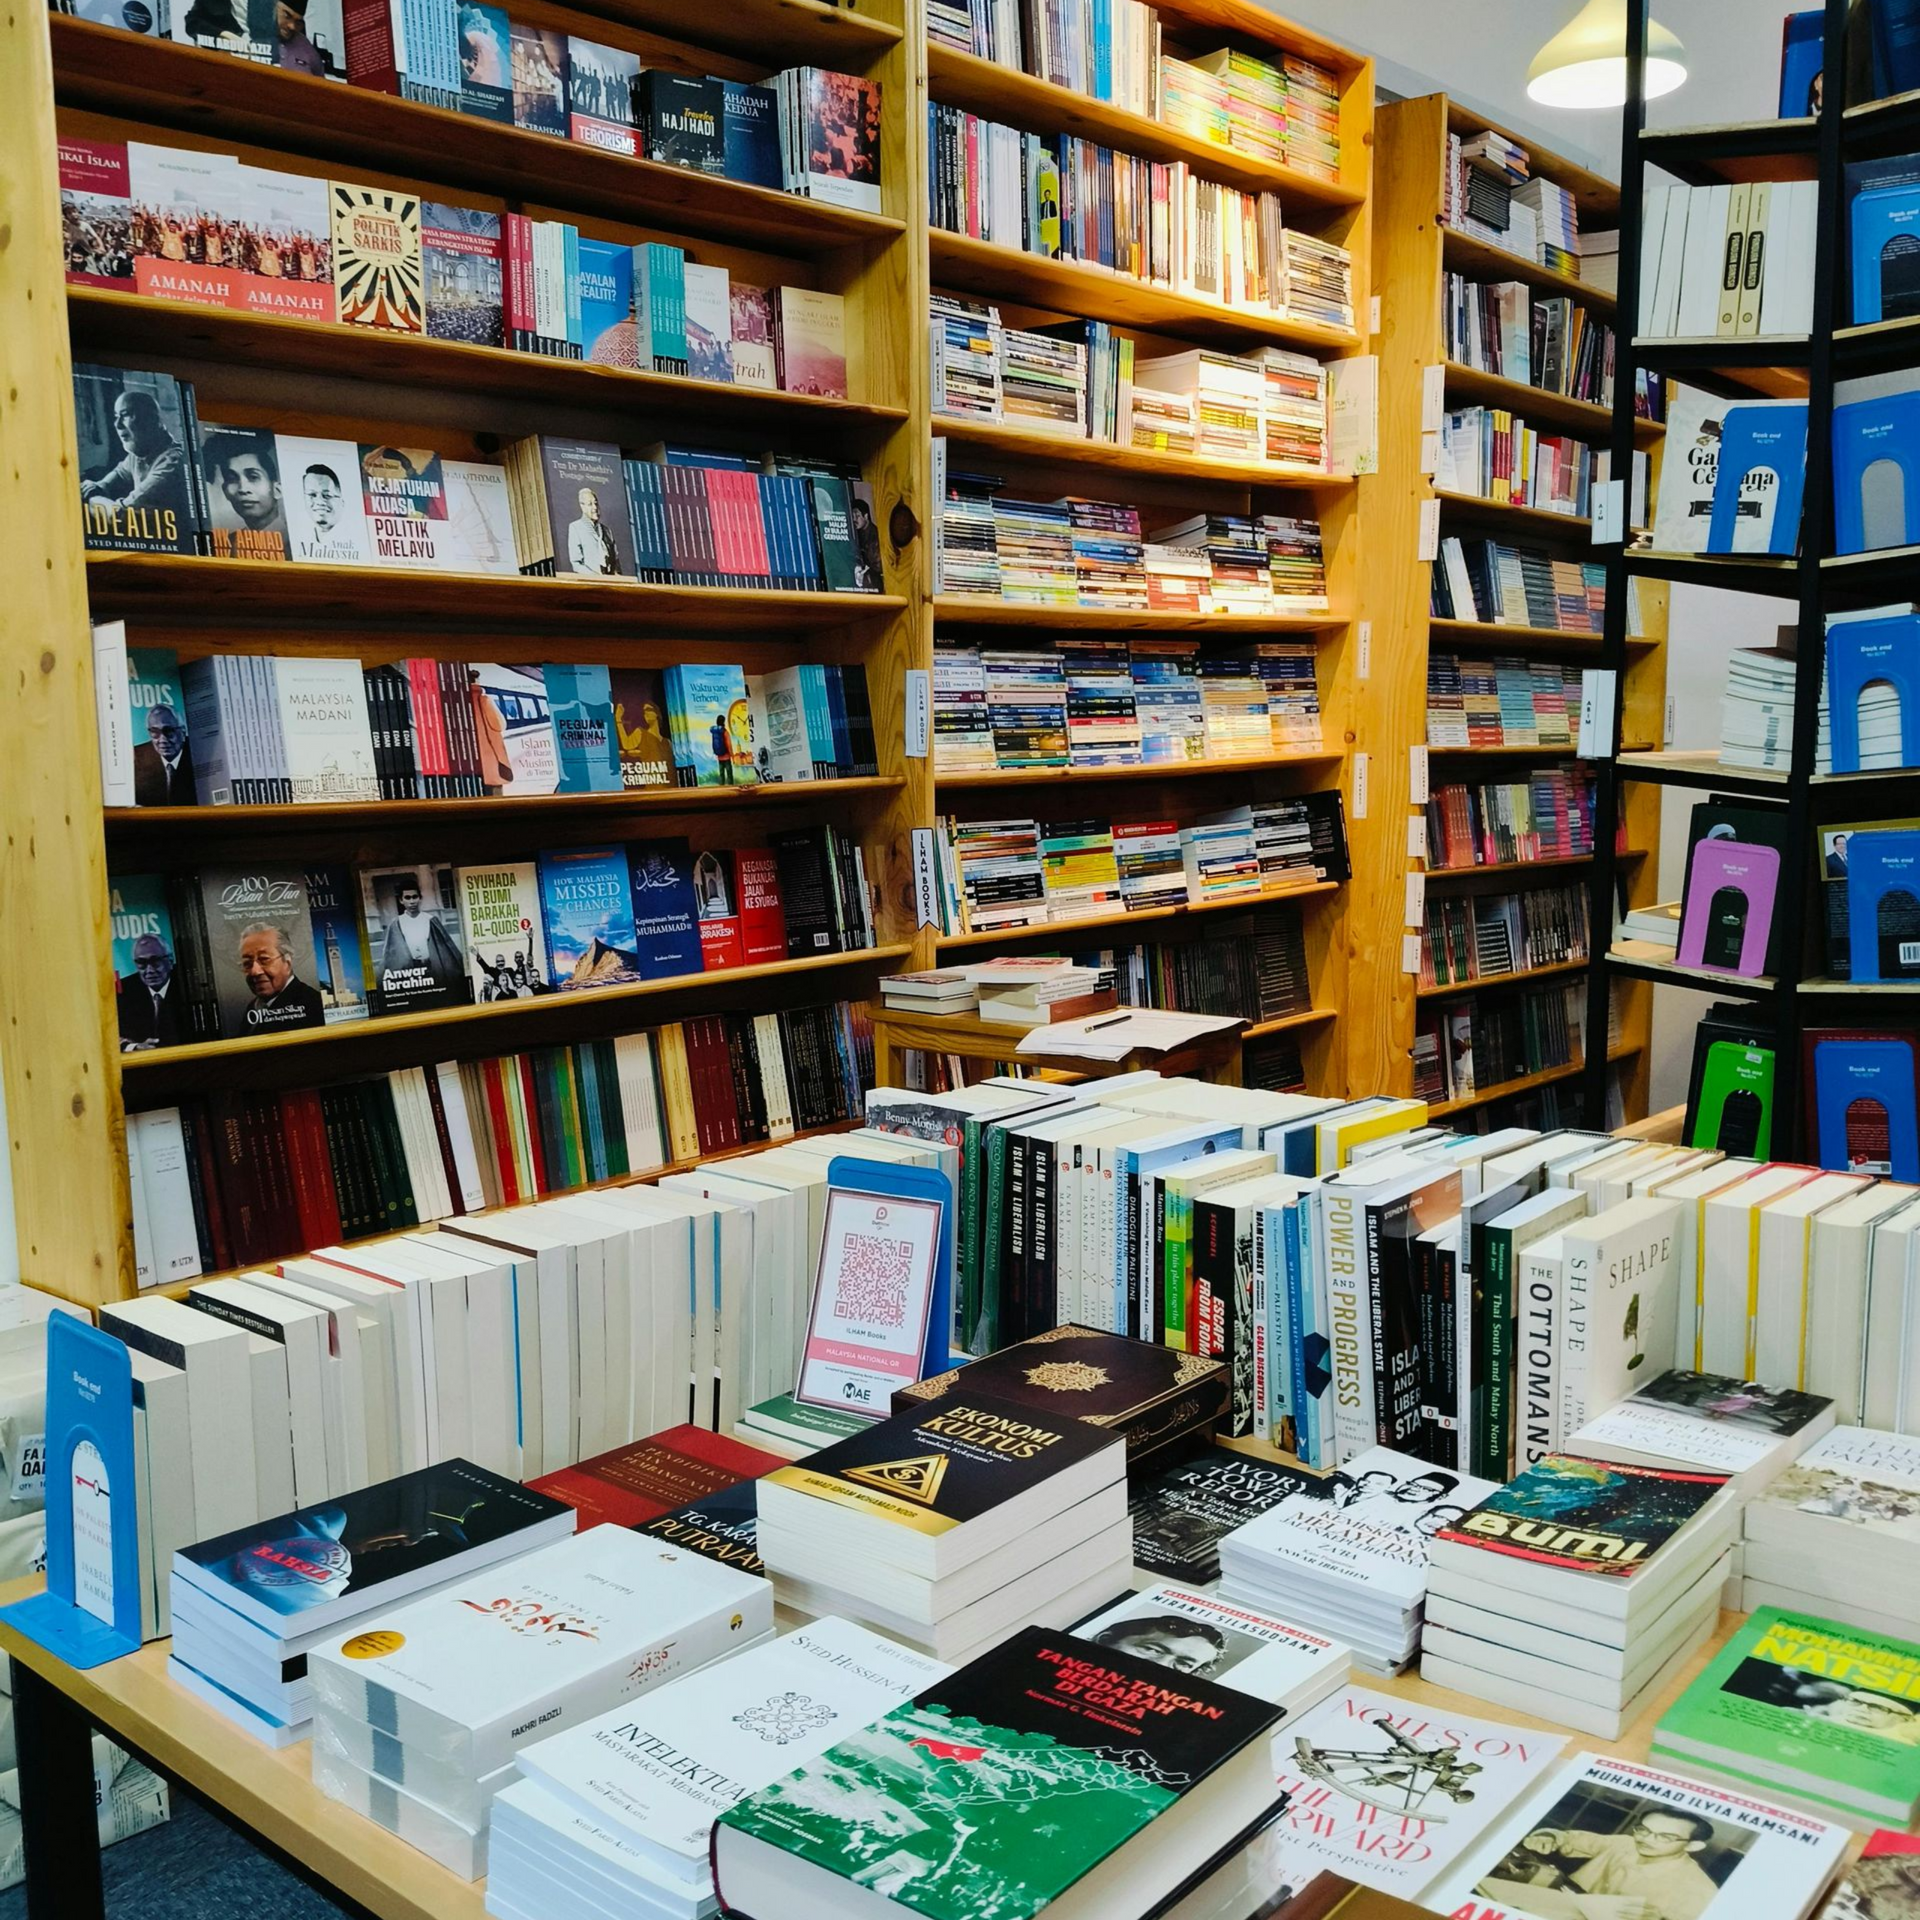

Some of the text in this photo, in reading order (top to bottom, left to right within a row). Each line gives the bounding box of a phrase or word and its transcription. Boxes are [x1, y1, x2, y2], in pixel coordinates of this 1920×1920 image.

[724, 102, 759, 118] KEDUA
[662, 112, 715, 137] HAJI HADI
[577, 127, 638, 153] TERORISME
[87, 155, 121, 170] ISLAM
[353, 218, 401, 238] POLITIK
[353, 233, 403, 254] SARKIS
[474, 246, 494, 255] ISLAM
[149, 273, 230, 297] AMANAH
[247, 289, 324, 310] AMANAH
[1752, 431, 1781, 440] Book end
[1862, 427, 1879, 435] Book
[368, 477, 440, 499] KEJATUHAN
[371, 495, 416, 515] KUASA
[84, 503, 178, 542] IDEALIS
[374, 518, 429, 538] POLITIK
[88, 540, 178, 552] SYED HAMID ALBAR
[236, 529, 284, 551] AHMAD
[377, 537, 435, 559] MELAYU
[1861, 644, 1892, 654] Book end
[289, 693, 354, 706] MALAYSIA
[297, 709, 352, 722] MADANI
[1882, 856, 1914, 865] Book end
[242, 876, 269, 892] 100
[467, 872, 517, 890] SYUHADA
[743, 871, 776, 885] BUKANLAH
[919, 832, 932, 918] ILHAM BOOKS
[555, 882, 620, 901] MISSED
[744, 884, 765, 897] JALAN
[470, 905, 520, 921] BARAKAH
[745, 896, 779, 909] KE SYURGA
[472, 920, 519, 938] AL-QUDS
[383, 967, 428, 980] Anwar
[383, 976, 435, 991] Ibrahim
[1736, 1066, 1763, 1078] Book end
[1849, 1066, 1881, 1074] Book end
[885, 1111, 943, 1131] Benny Morris
[1012, 1146, 1023, 1255] ISLAM IN LIBERALISM
[1035, 1151, 1046, 1260] ISLAM IN LIBERALISM
[1129, 1196, 1137, 1244] DIALOGUE
[1130, 1245, 1136, 1254] IN
[1256, 1211, 1264, 1276] NOAM CHOMSKY
[1529, 1266, 1553, 1280] THE
[1608, 1236, 1671, 1289] SHAPE
[1328, 1196, 1360, 1408] POWER AND PROGRESS
[1568, 1257, 1588, 1353] SHAPE
[196, 1299, 276, 1335] THE SUNDAY TIMES BESTSELLER
[1213, 1296, 1225, 1352] ESCAPE
[846, 1326, 887, 1341] ILHAM Books
[1257, 1325, 1266, 1411] GLOBAL DISCONTENTS
[1489, 1294, 1503, 1457] Thai South and Malay North
[1527, 1283, 1553, 1465] OTTOMANS
[72, 1371, 102, 1395] Book end
[842, 1382, 872, 1400] MAE
[1393, 1372, 1414, 1395] AND
[920, 1415, 1043, 1460] KULTUS
[943, 1405, 1064, 1448] EKONOMI
[1225, 1460, 1307, 1493] IVORY
[1151, 1594, 1320, 1656] MIRANTI SILASUDJANA
[1775, 1616, 1846, 1640] Pemikiran
[1847, 1636, 1876, 1648] dan
[875, 1643, 903, 1659] KARYA
[790, 1633, 833, 1663] SYED
[830, 1653, 897, 1692] HUSSEIN
[1036, 1648, 1226, 1721] TANGAN-TANGAN
[1055, 1667, 1177, 1716] BERDARAH
[1054, 1679, 1147, 1720] DI GAZA
[511, 1706, 563, 1740] FAKHRI FADZLI
[1331, 1698, 1541, 1764] NOTES ON
[591, 1729, 670, 1780] MASYARAKAT
[586, 1779, 649, 1822] SYED FARID ALATAS
[1276, 1774, 1445, 1841] THE WAY
[1585, 1766, 1684, 1804] MUHAMMAD
[1736, 1810, 1821, 1848] KAMSANI
[1308, 1840, 1410, 1878] Perspective
